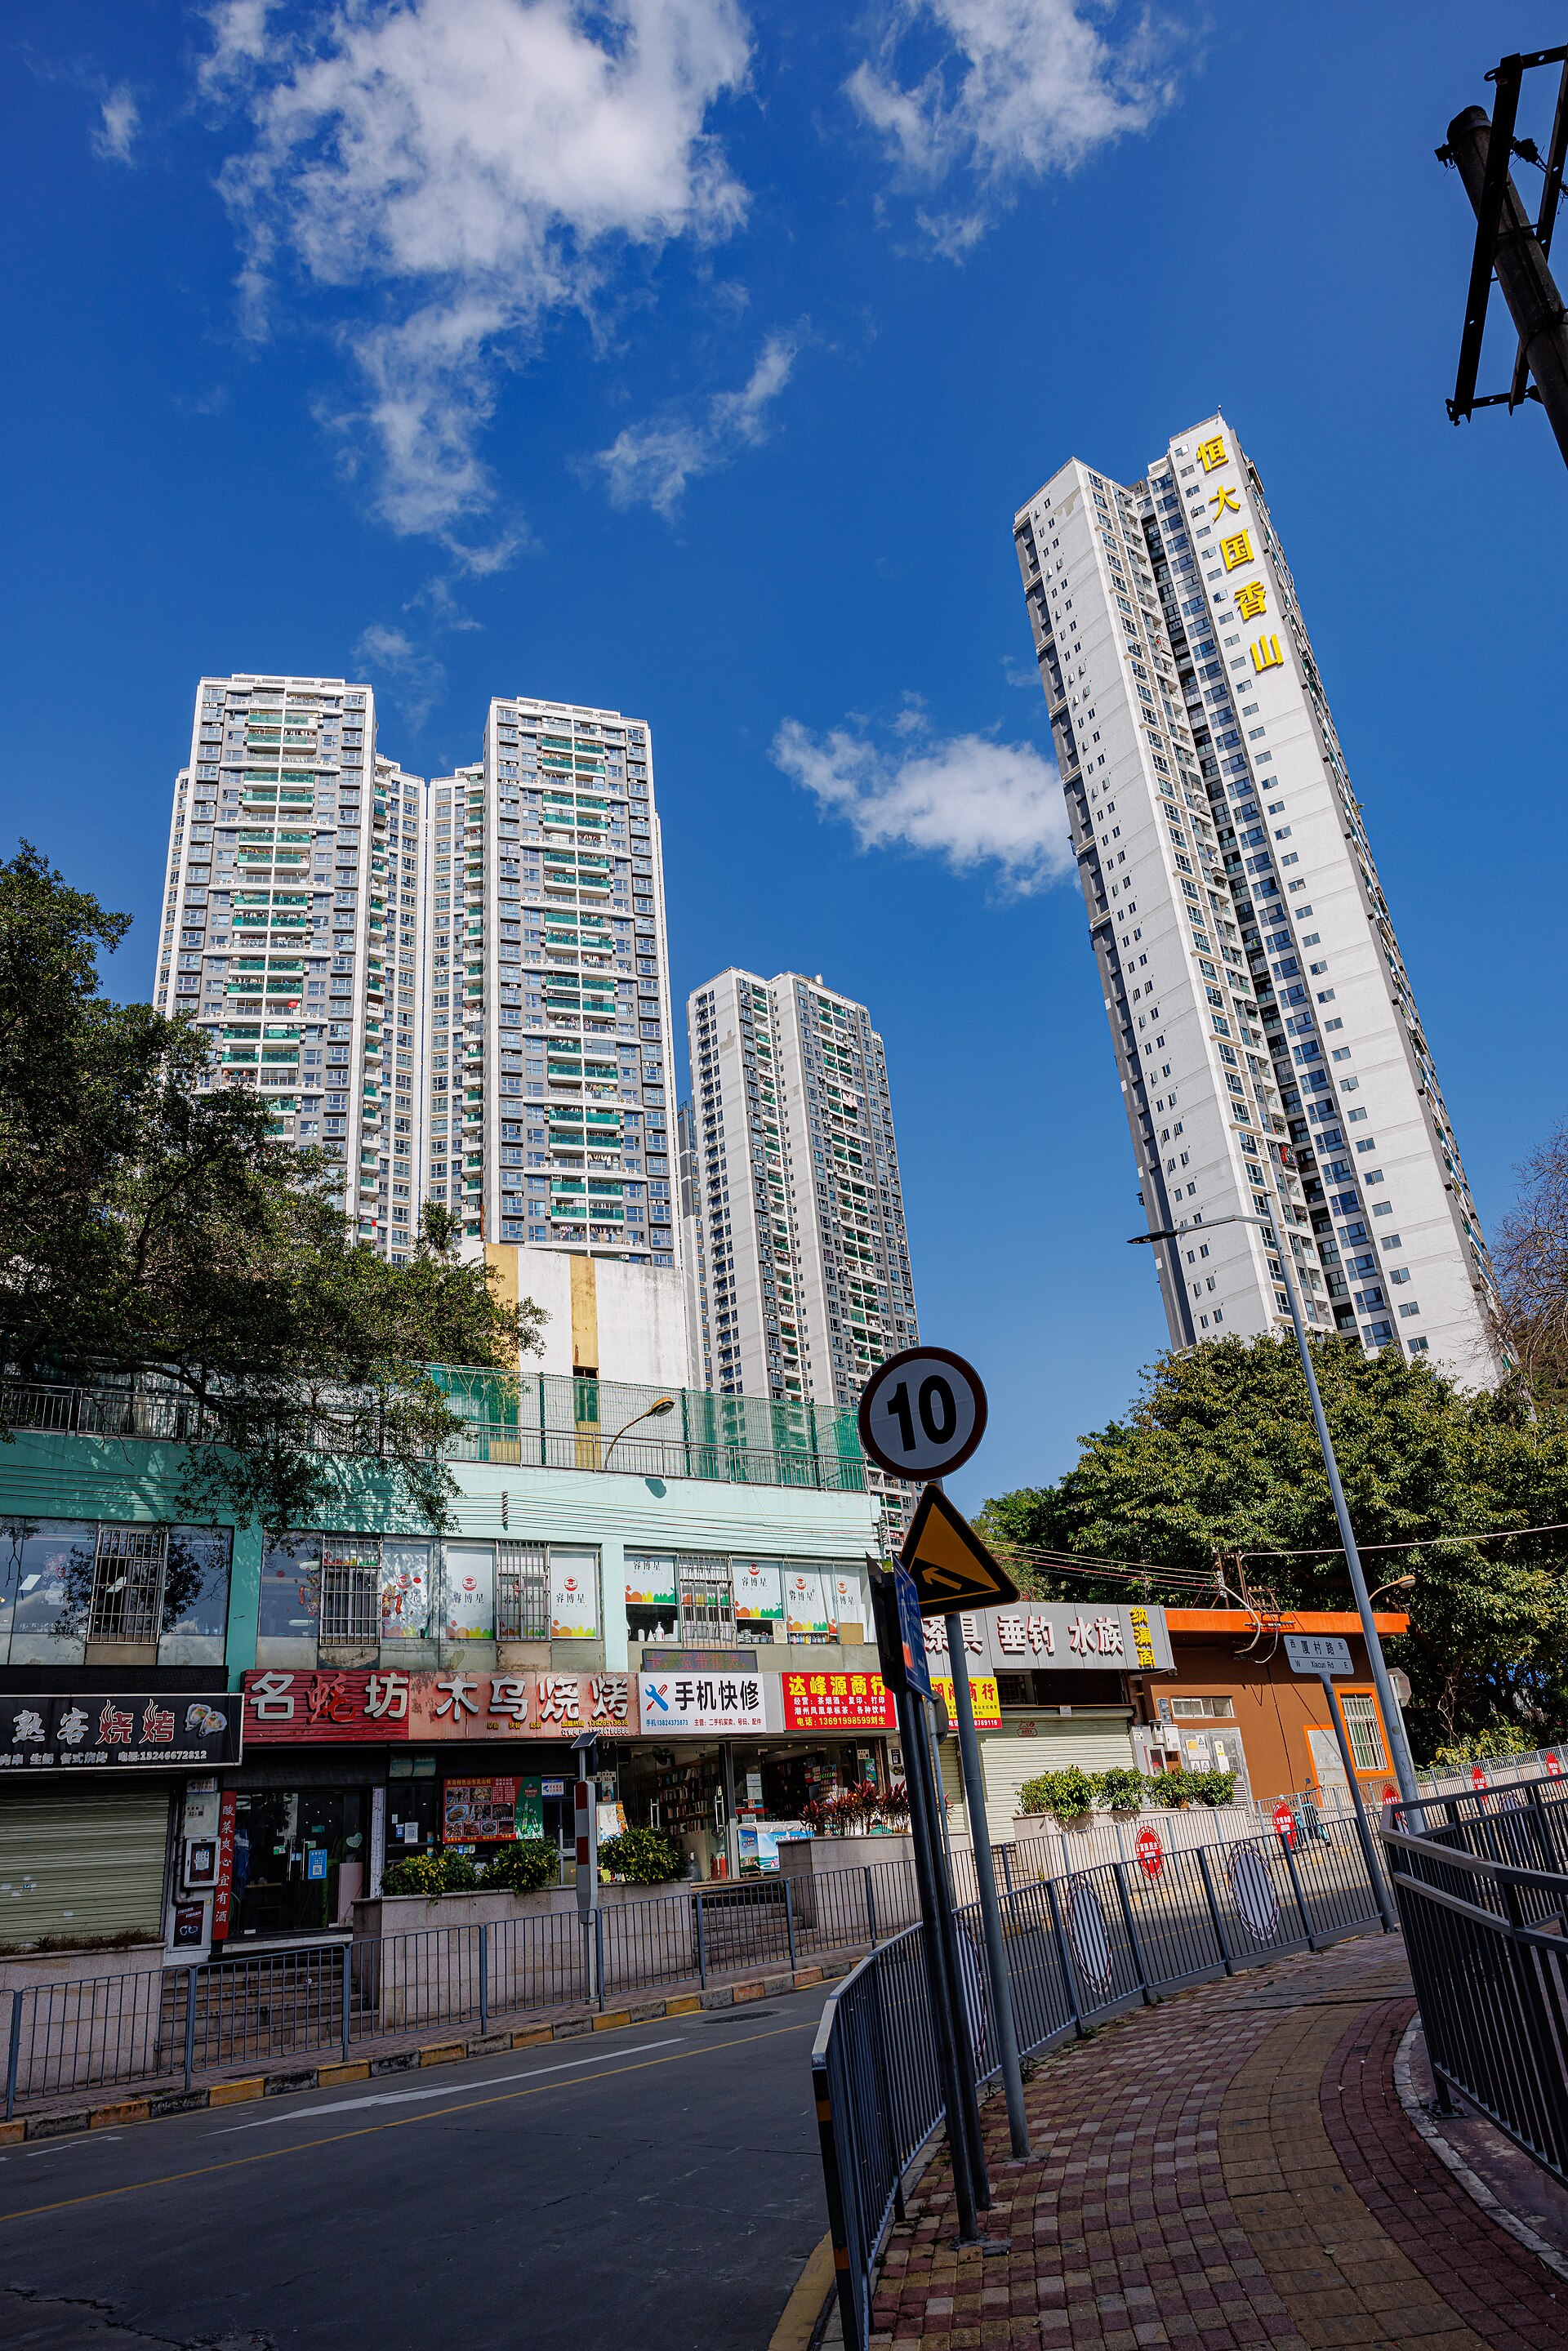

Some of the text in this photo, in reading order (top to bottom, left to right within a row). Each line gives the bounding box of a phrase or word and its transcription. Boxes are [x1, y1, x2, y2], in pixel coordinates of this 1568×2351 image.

[1196, 434, 1284, 672] 恒大国香山
[886, 1374, 957, 1452] 10
[997, 1614, 1056, 1656] 垂钓
[1067, 1616, 1124, 1657] 水族
[1129, 1606, 1156, 1668] 纳澜阁
[436, 1675, 630, 1721] 木乌烧烤
[675, 1680, 760, 1711] 手机快修
[789, 1675, 886, 1696] 达峰源商行
[12, 1699, 175, 1745] 熟客烧烤
